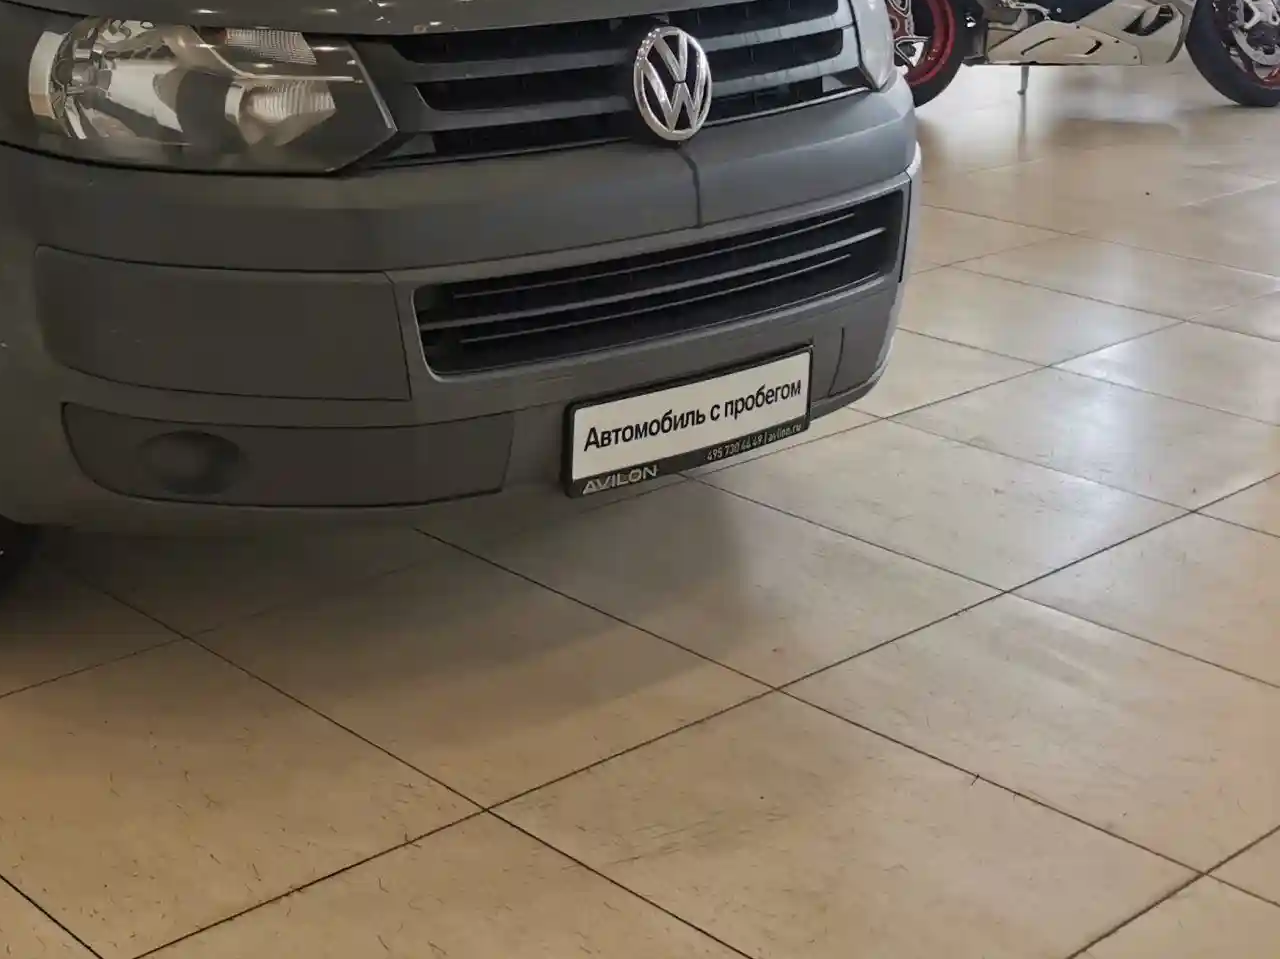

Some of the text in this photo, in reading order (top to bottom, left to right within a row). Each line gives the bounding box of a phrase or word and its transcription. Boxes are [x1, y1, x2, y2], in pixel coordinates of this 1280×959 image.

[583, 379, 802, 452] Автомобиль с пробегом
[582, 465, 657, 495] AVILON
